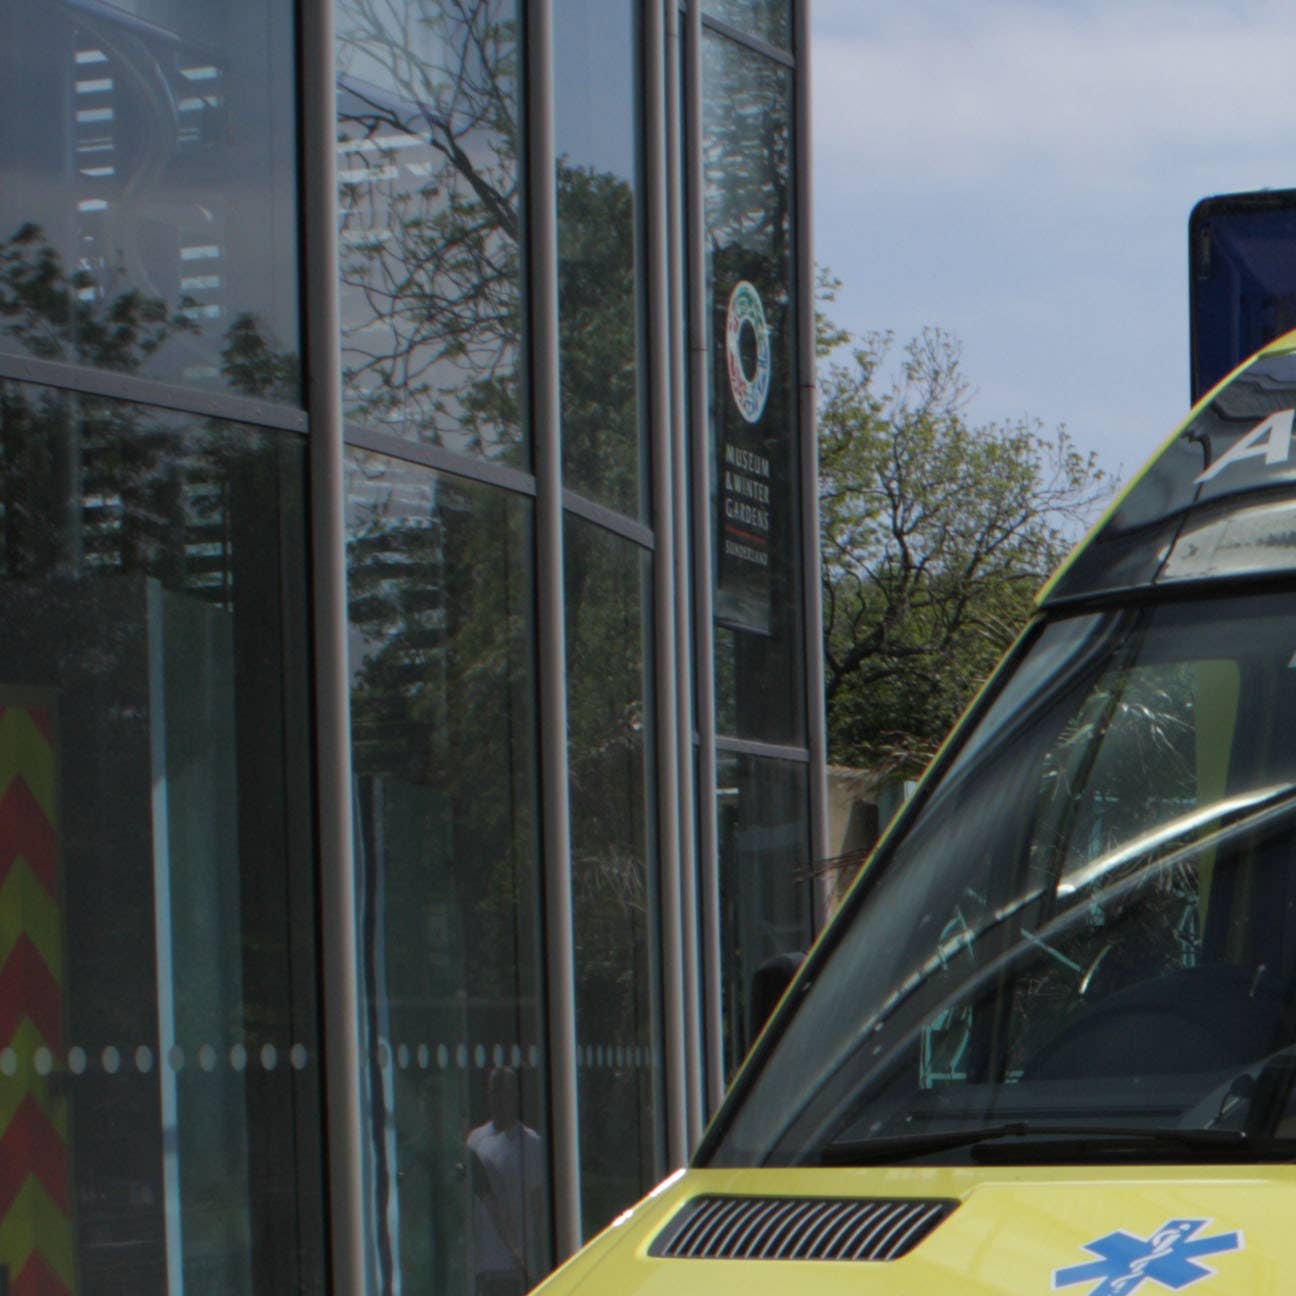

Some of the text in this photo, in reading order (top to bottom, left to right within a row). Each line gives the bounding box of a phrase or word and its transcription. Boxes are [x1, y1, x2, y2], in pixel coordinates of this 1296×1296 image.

[725, 443, 770, 479] MUSEUM
[725, 498, 769, 531] GARDENS
[725, 540, 768, 566] SUNDERLAND
